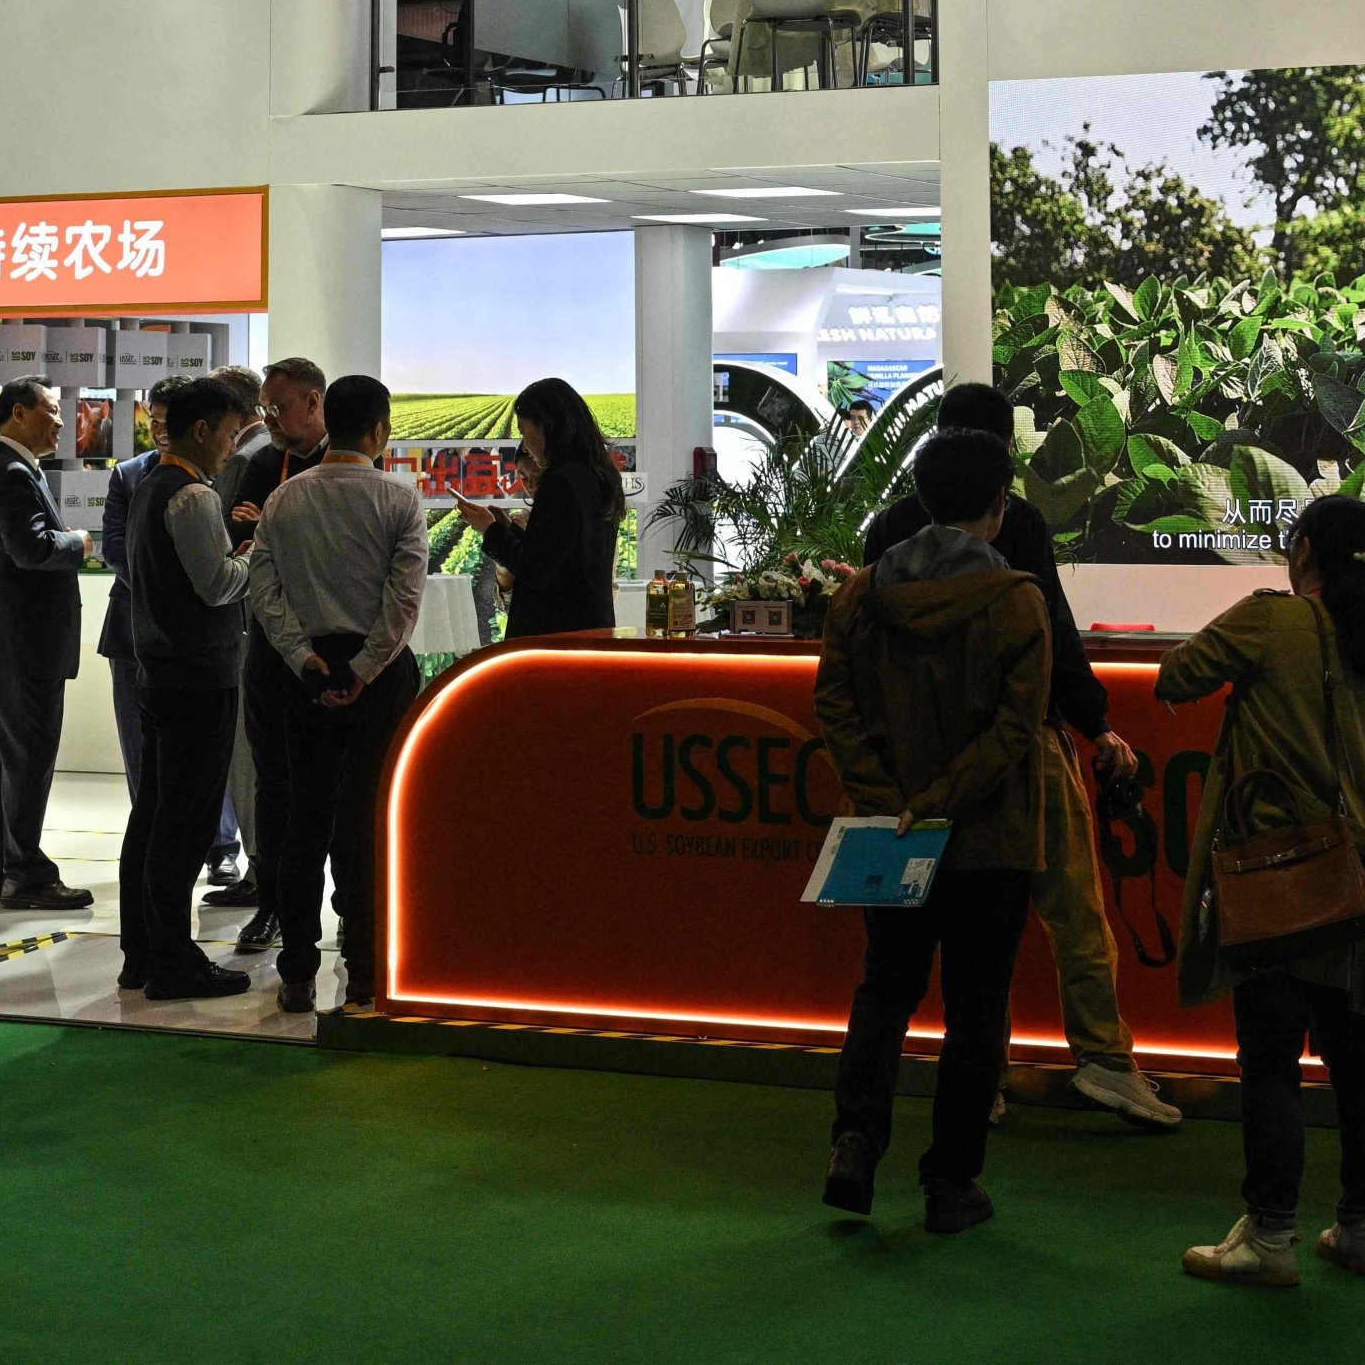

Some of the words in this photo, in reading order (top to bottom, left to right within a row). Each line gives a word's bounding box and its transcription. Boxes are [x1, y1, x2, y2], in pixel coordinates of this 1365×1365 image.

[21, 350, 36, 362] SOY
[78, 352, 94, 363] SOY
[150, 355, 163, 366] SOY
[189, 357, 204, 368] SOY
[1152, 530, 1172, 550] to
[1178, 528, 1272, 551] minimize
[631, 731, 833, 827] USSEC
[666, 833, 736, 860] SOYBEAN
[741, 838, 801, 862] EXPORT
